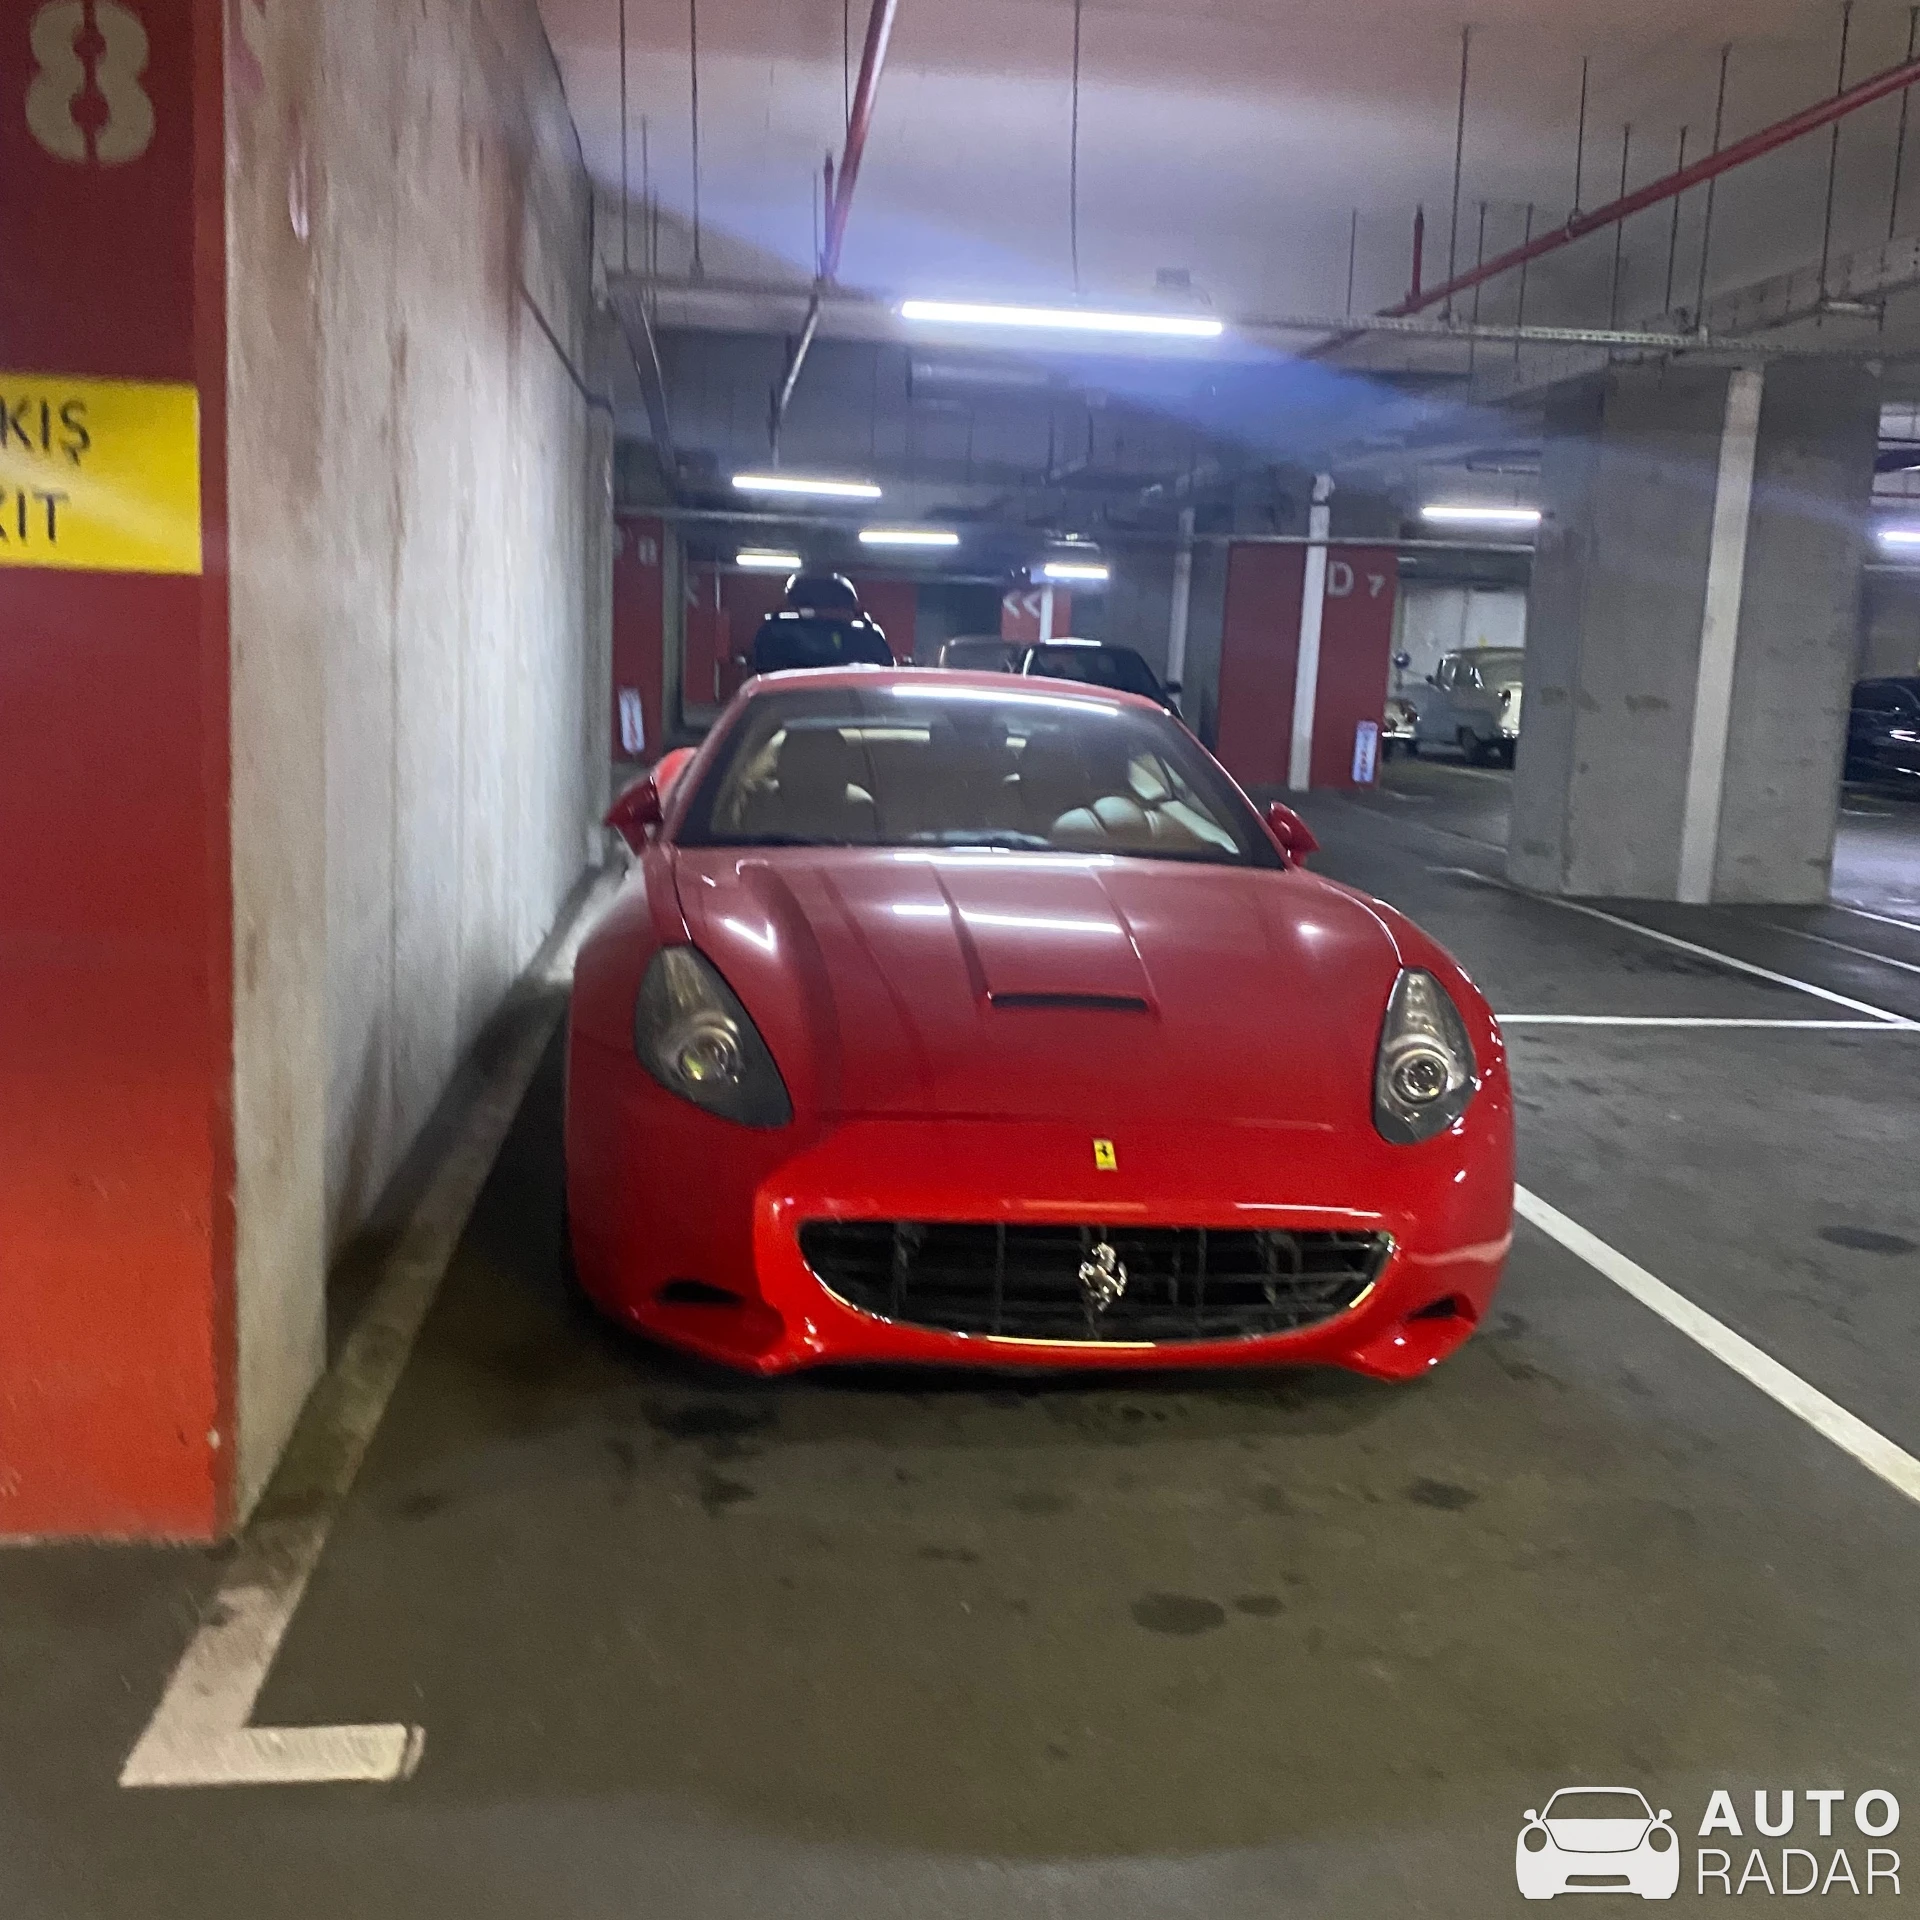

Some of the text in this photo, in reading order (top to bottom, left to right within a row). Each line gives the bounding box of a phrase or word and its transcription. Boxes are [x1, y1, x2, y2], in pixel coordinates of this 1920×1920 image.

[25, 0, 155, 165] 8
[0, 485, 70, 543] IT
[1328, 560, 1354, 597] D
